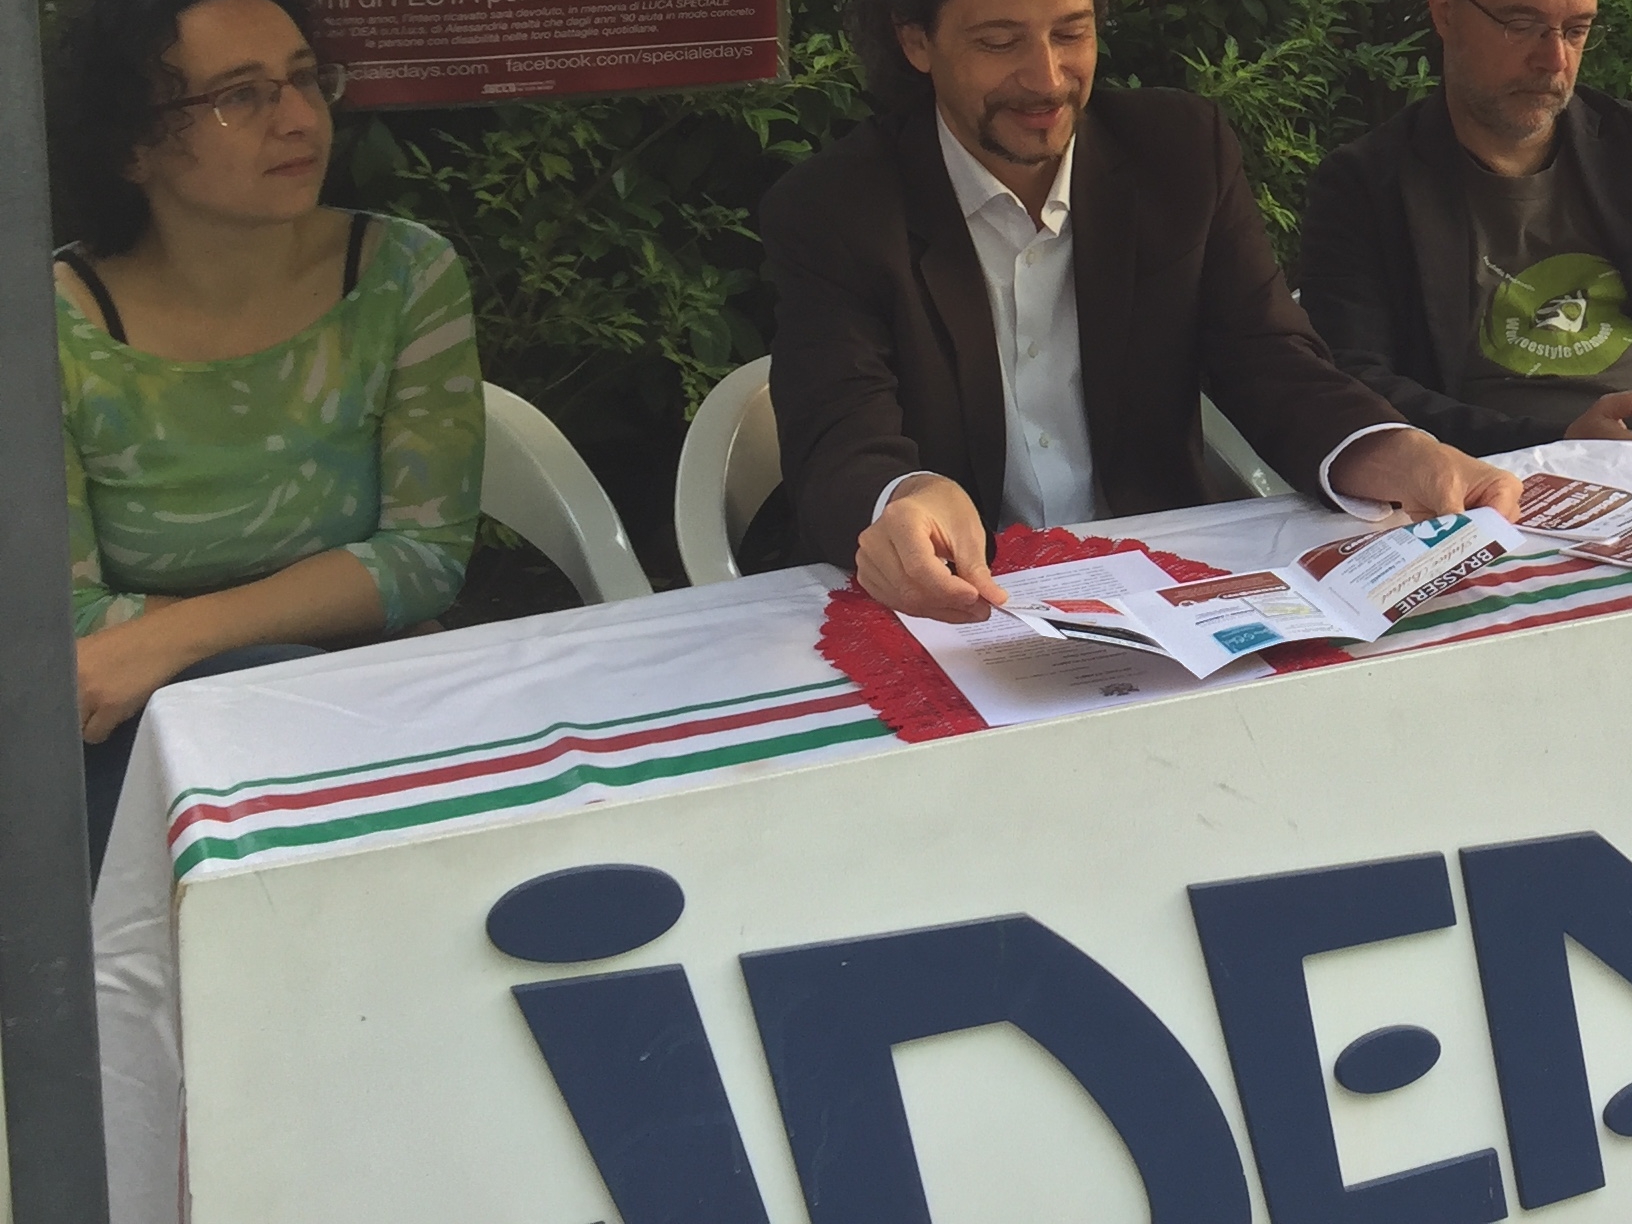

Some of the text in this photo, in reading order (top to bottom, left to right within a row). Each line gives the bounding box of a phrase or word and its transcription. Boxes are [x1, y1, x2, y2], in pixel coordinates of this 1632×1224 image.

[629, 0, 640, 11] di
[642, 0, 672, 10] LUCA
[678, 8, 708, 20] modo
[710, 7, 756, 18] concreto
[346, 44, 754, 81] cialedays.com facebook.com/specialedays
[1395, 547, 1494, 616] BRASSERIE
